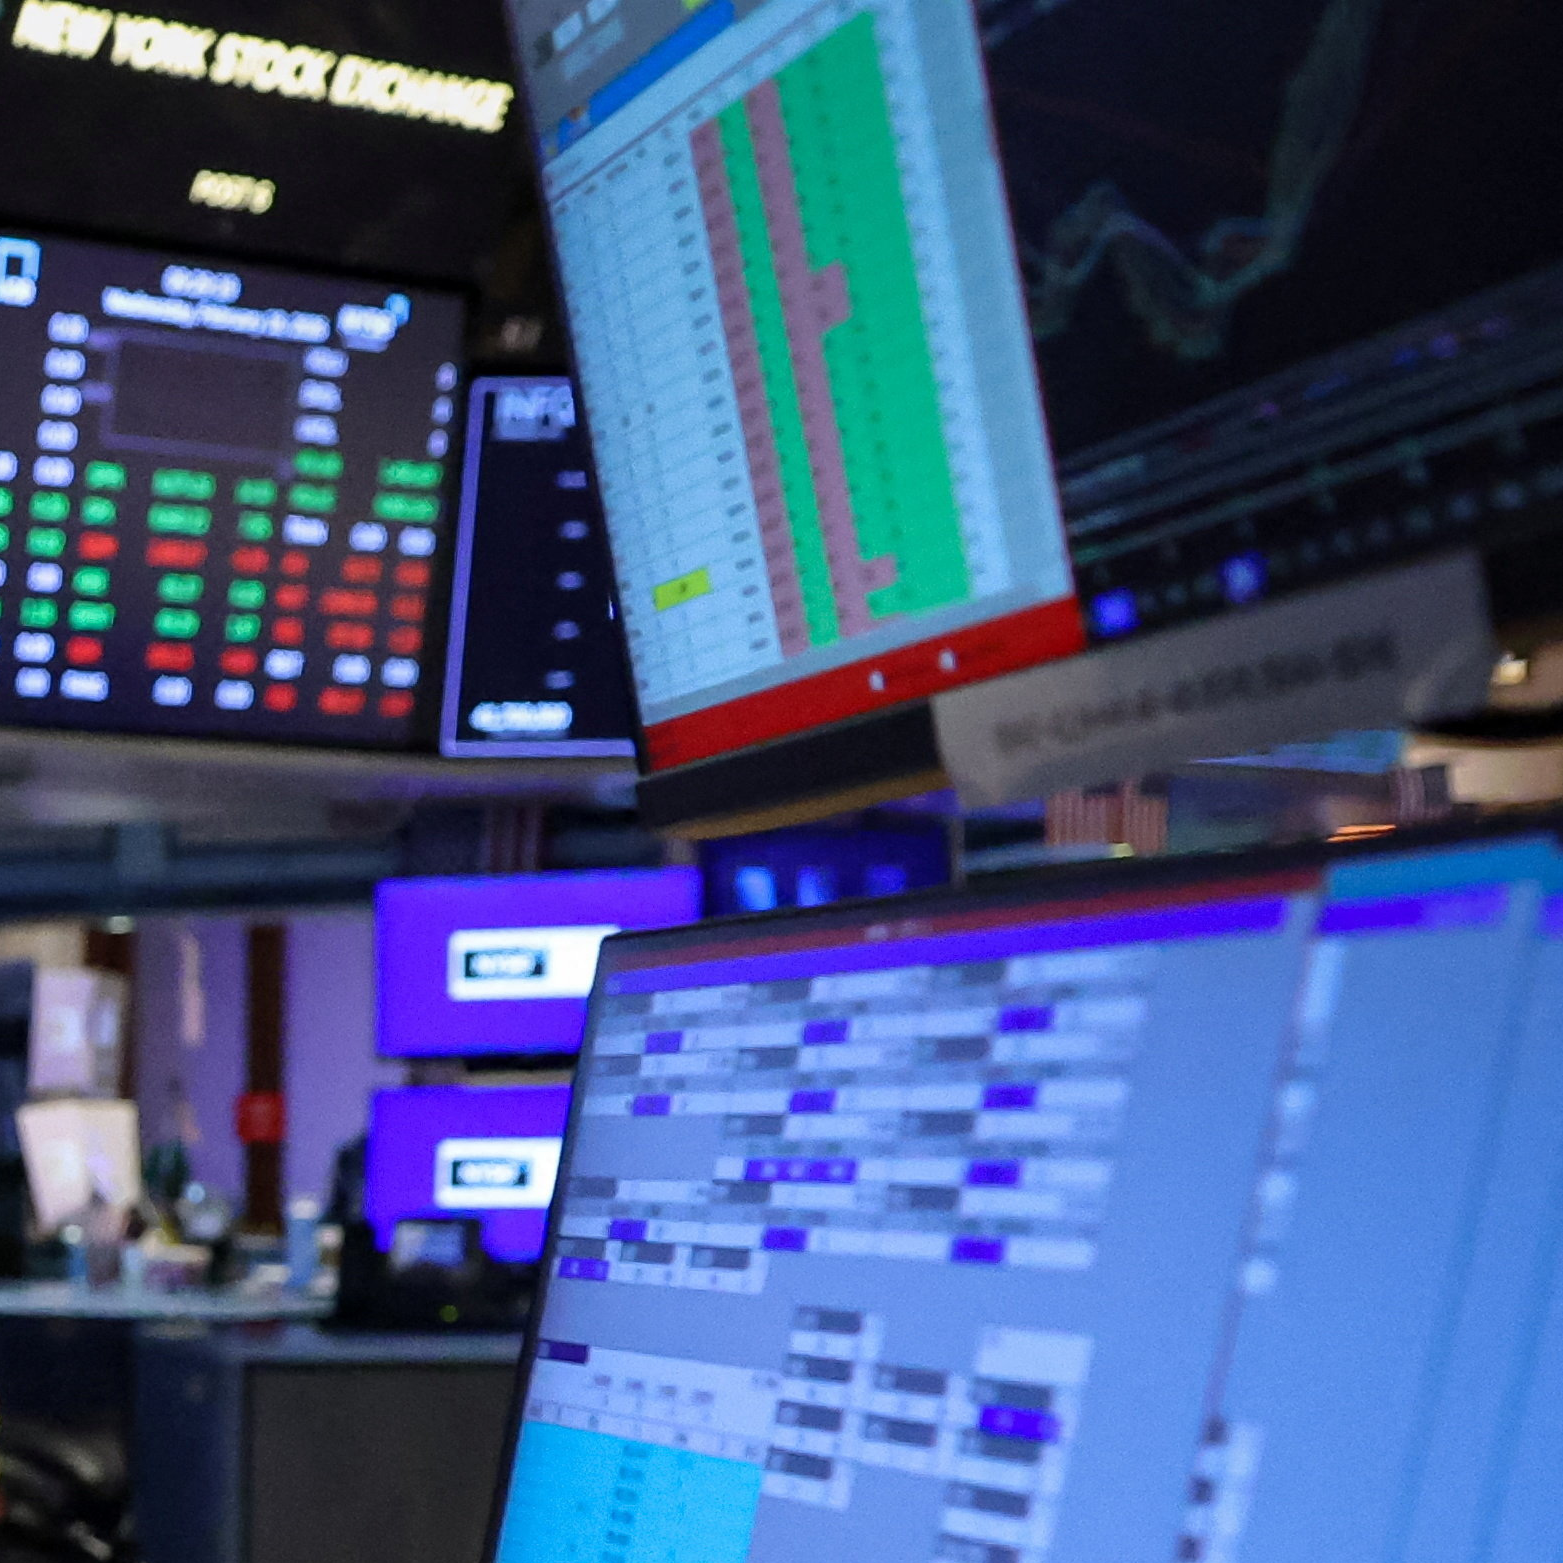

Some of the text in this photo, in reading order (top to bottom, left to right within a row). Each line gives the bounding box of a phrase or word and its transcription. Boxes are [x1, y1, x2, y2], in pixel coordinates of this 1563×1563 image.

[12, 0, 515, 133] NEW YORK STOCK EXCHANGE
